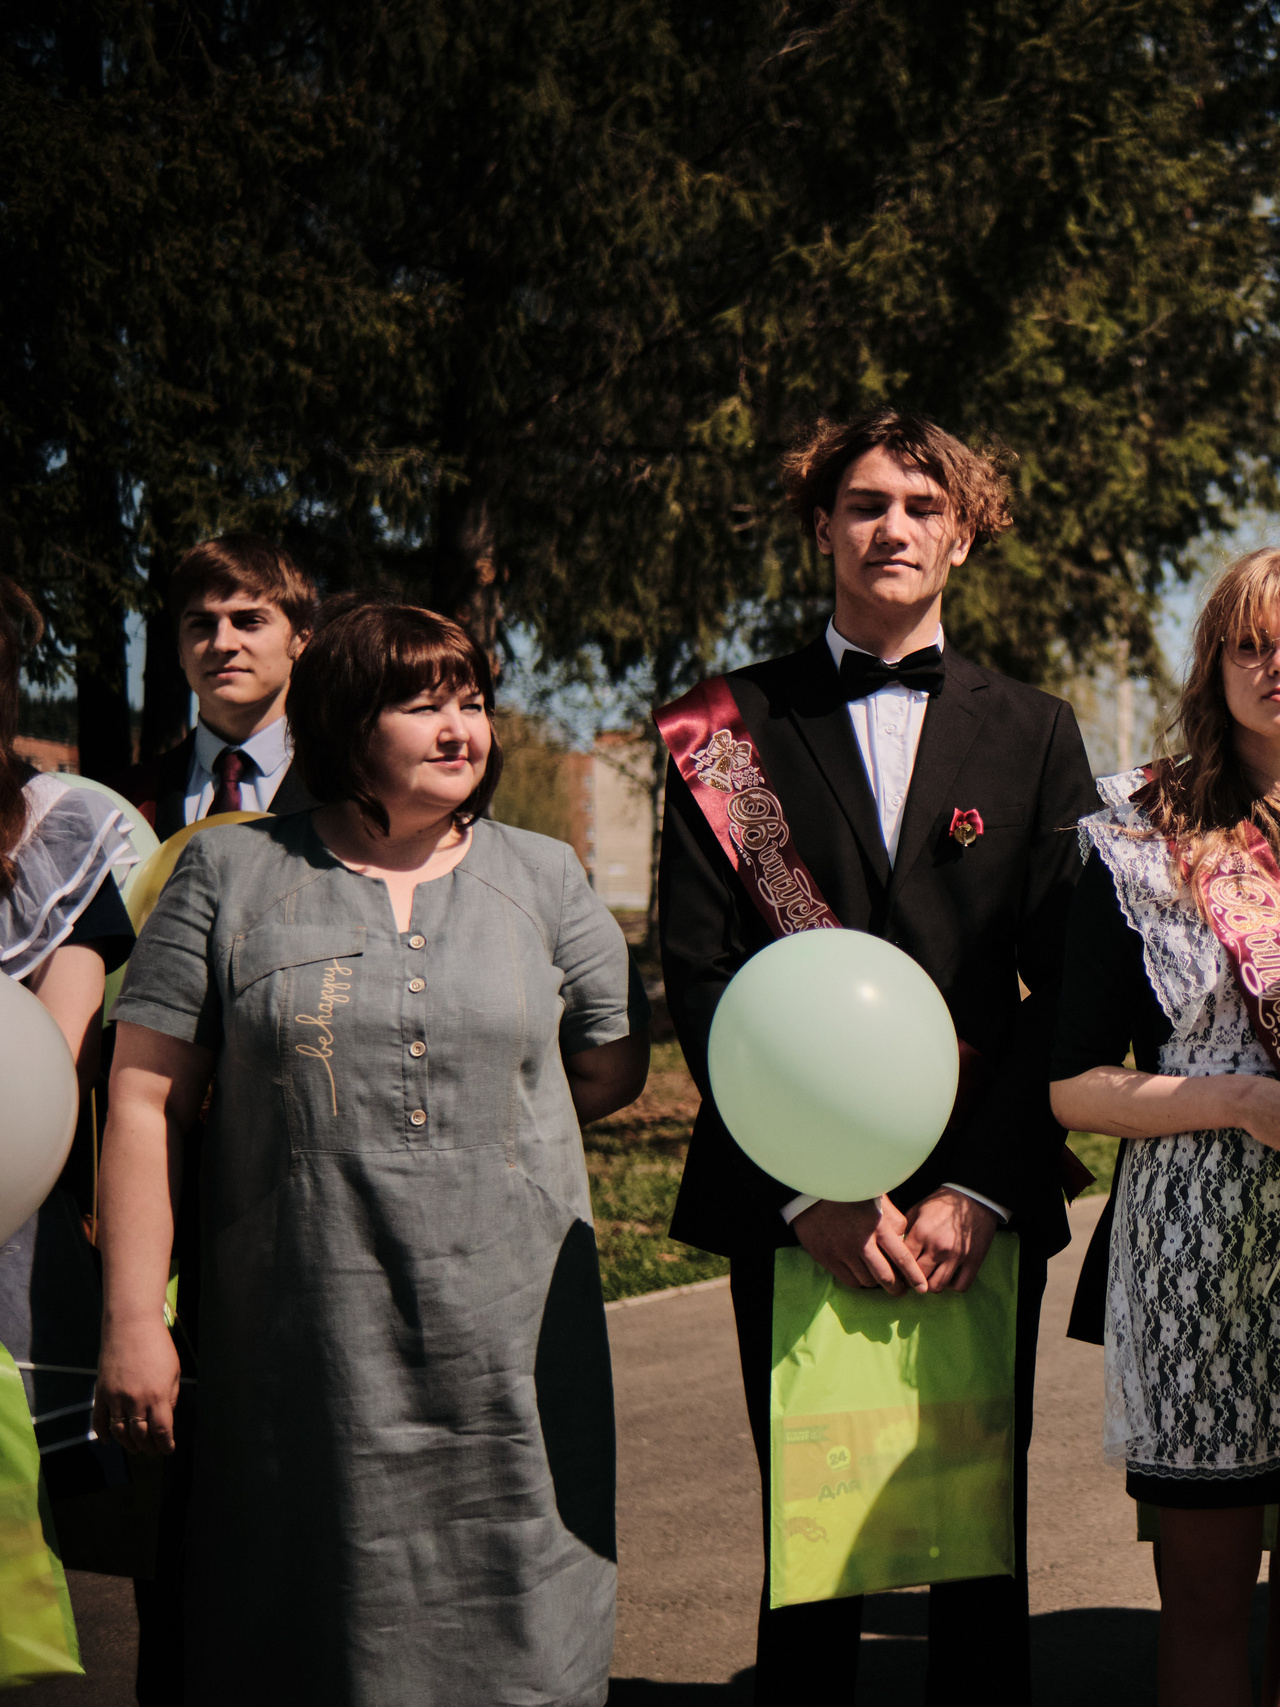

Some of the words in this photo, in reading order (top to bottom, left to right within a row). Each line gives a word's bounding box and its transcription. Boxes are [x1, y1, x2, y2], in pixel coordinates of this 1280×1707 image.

[727, 787, 837, 934] Выпуск
[295, 958, 353, 1030] happy
[829, 1449, 849, 1467] 24
